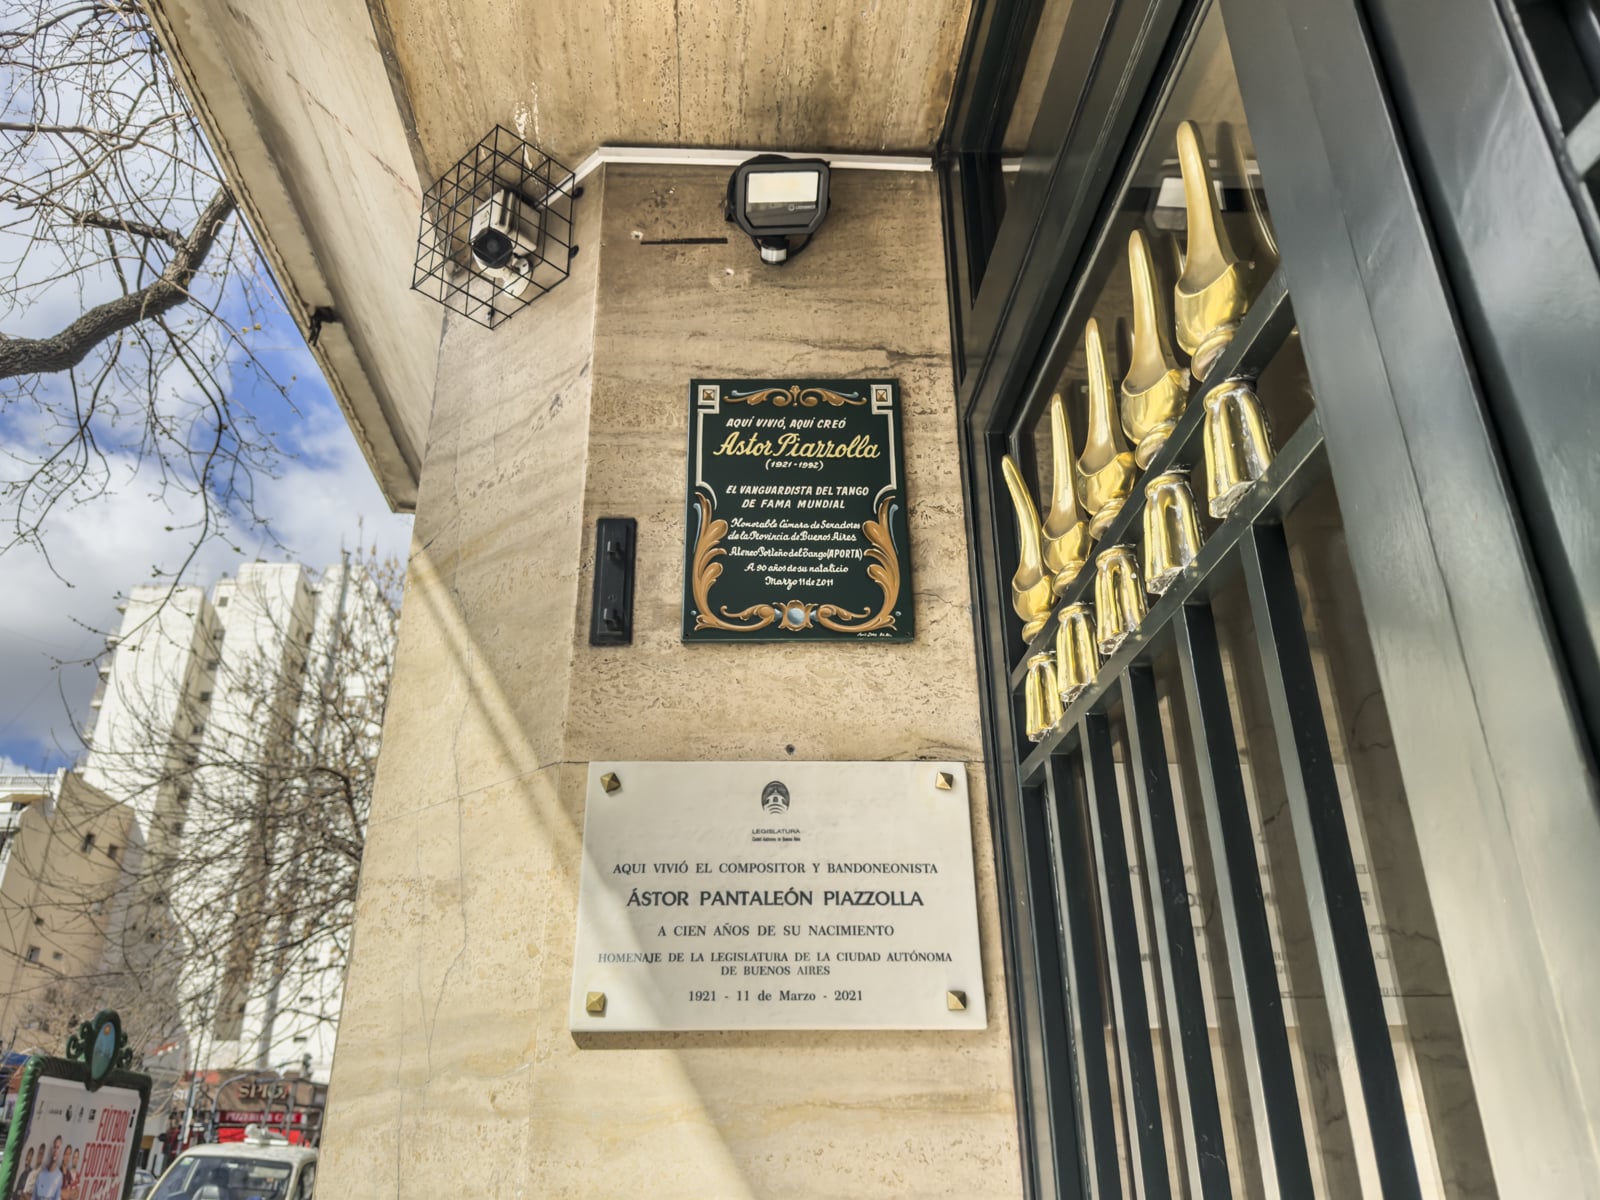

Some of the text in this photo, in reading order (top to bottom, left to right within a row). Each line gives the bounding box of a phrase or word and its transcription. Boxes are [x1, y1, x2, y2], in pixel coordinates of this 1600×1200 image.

[726, 416, 847, 430] AQUÍ VIVIÓ, AQUÍ CREÓ
[713, 431, 881, 458] Astor Piazzolla
[726, 485, 870, 496] EL VANGUARDISTA DEL TANGO
[741, 499, 846, 509] DE FAMA MUNDIAL
[730, 517, 778, 529] Honorable
[810, 521, 820, 529] de
[820, 520, 860, 529] Senadores
[727, 530, 857, 541] de la Provincia de Buenos Aires
[789, 547, 802, 557] del
[744, 562, 755, 572] A
[756, 564, 767, 572] 90
[768, 564, 787, 572] años
[787, 564, 797, 572] de
[809, 563, 849, 573] natalicio
[765, 576, 798, 591] Marzo
[805, 578, 816, 586] de
[816, 579, 834, 587] 2011
[613, 860, 938, 876] AQUI VIVIÓ EL COMPOSITOR Y BANDONEONISTA
[626, 887, 924, 906] ÁSTOR PANTALEÓN PIAZZOLLA
[657, 923, 894, 936] A CIEN AÑOS DE SU NACIMIENTO
[598, 950, 952, 964] HOMENAJE DE LA LEGISLATURA DE LA CIUDAD AUTÓNOMA
[721, 966, 830, 976] DE BUENOS AIRES
[689, 990, 716, 1001] 1921
[737, 990, 750, 1001] 11
[757, 990, 772, 1001] de
[779, 990, 816, 1001] Marzo
[834, 990, 863, 1001] 2021
